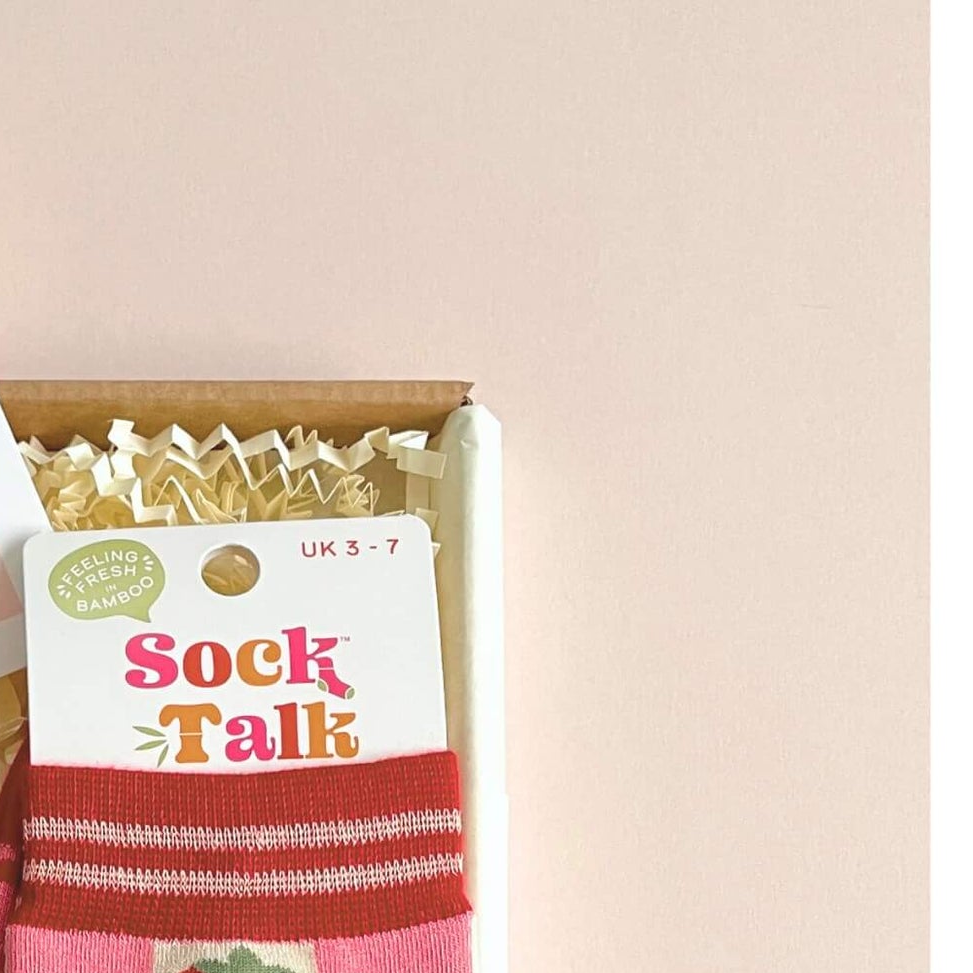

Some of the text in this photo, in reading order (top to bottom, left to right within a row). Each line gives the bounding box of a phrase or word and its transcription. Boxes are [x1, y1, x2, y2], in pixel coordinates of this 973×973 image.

[301, 540, 337, 558] UK
[345, 540, 360, 556] 3
[386, 539, 399, 554] 7
[61, 550, 138, 585] FEELING
[75, 565, 137, 594] FRESH
[76, 576, 154, 612] BAMBOO
[105, 583, 117, 593] IN
[124, 626, 355, 699] Sock
[159, 701, 359, 763] Talk
